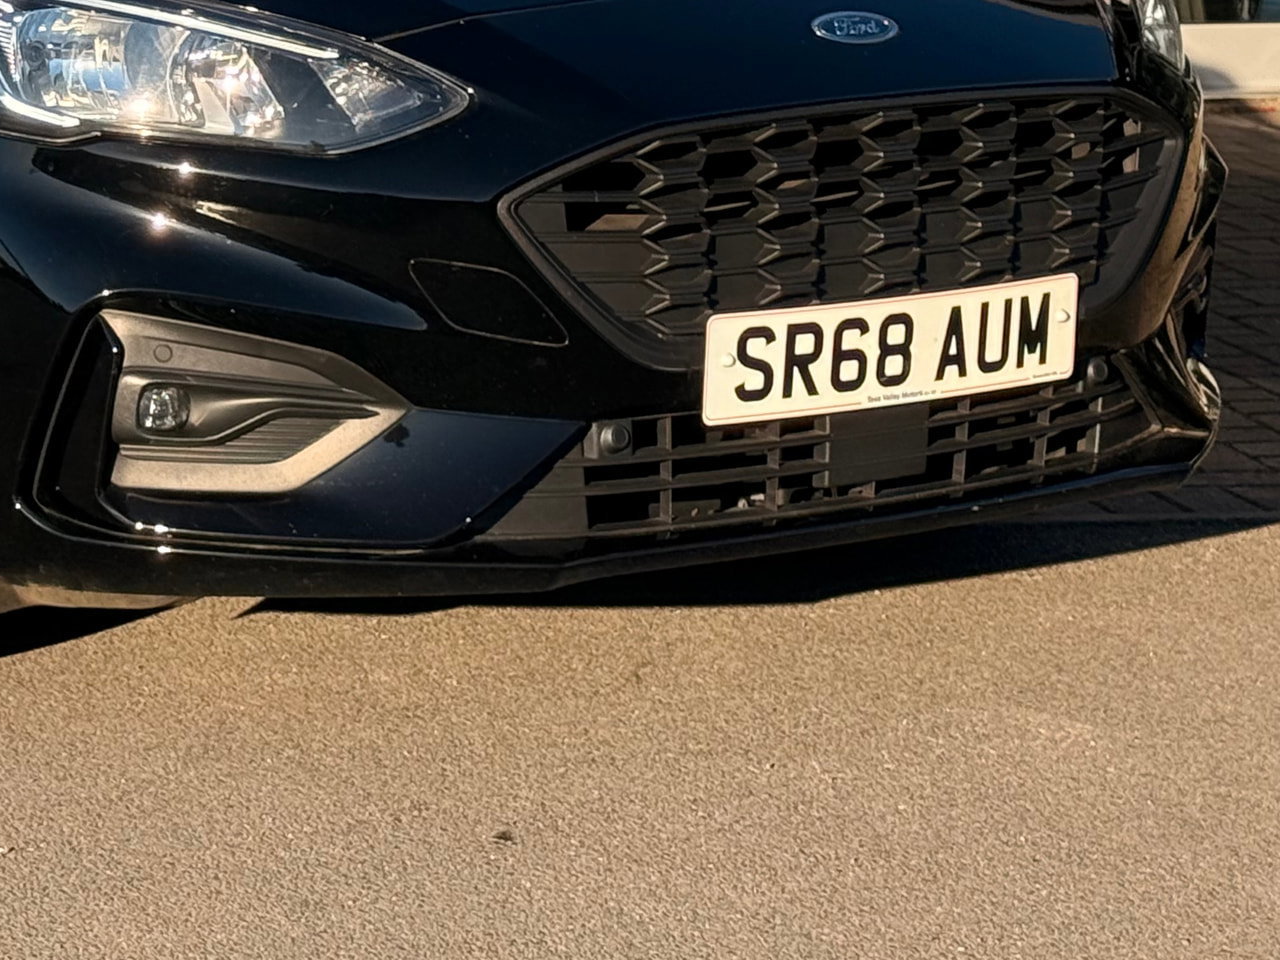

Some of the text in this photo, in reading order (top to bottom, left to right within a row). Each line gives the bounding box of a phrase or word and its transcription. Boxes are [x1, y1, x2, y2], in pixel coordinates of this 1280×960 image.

[833, 17, 880, 36] Ford
[734, 291, 1051, 403] SR68 AUM
